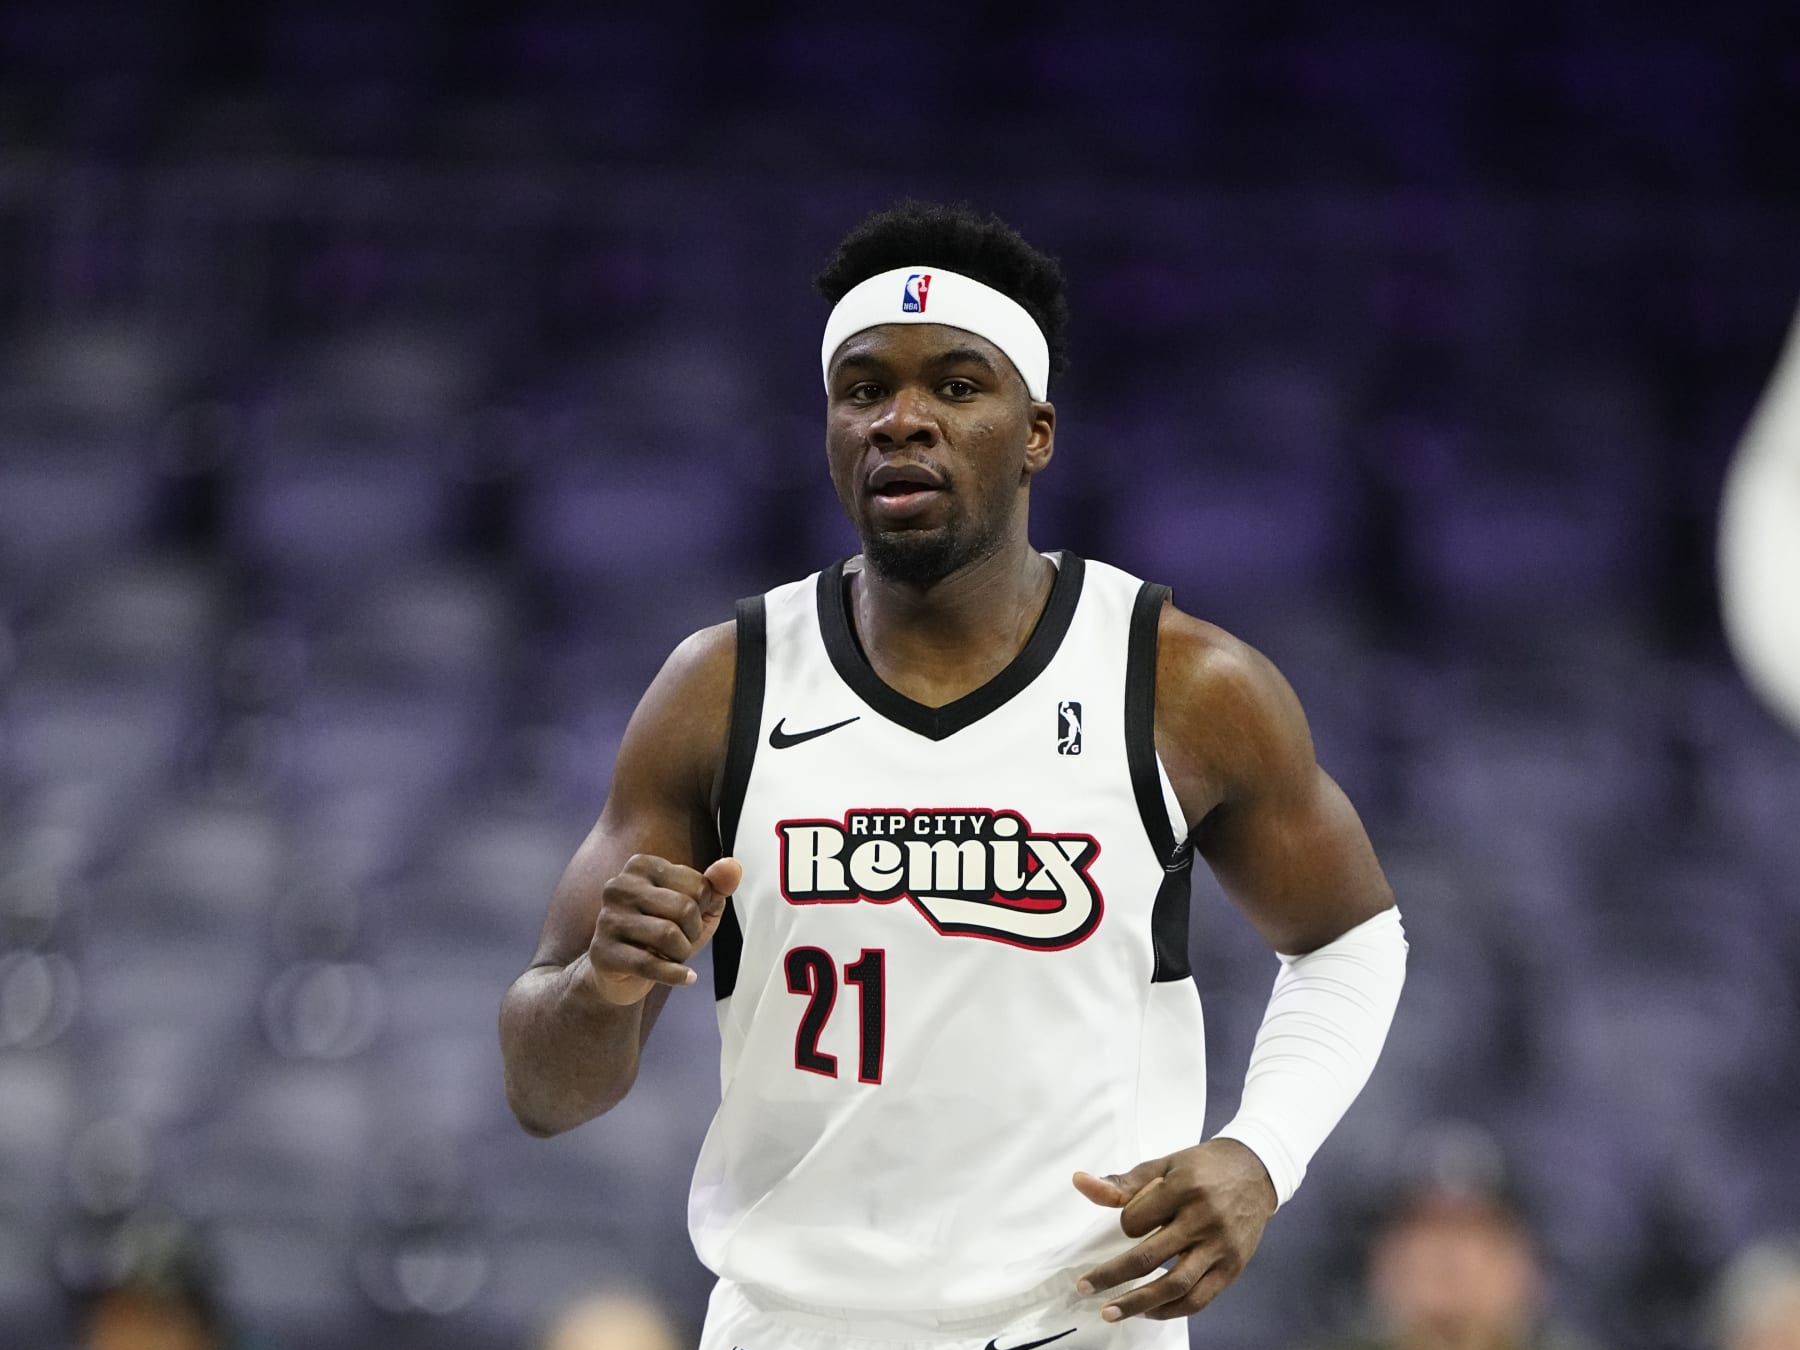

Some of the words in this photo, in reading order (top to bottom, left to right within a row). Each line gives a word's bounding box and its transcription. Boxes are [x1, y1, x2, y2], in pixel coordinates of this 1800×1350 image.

[903, 302, 918, 311] NBA
[1071, 744, 1079, 753] G
[852, 815, 906, 835] RIP
[914, 815, 986, 835] CITY
[780, 815, 1095, 942] Remix
[784, 946, 886, 1084] 21
